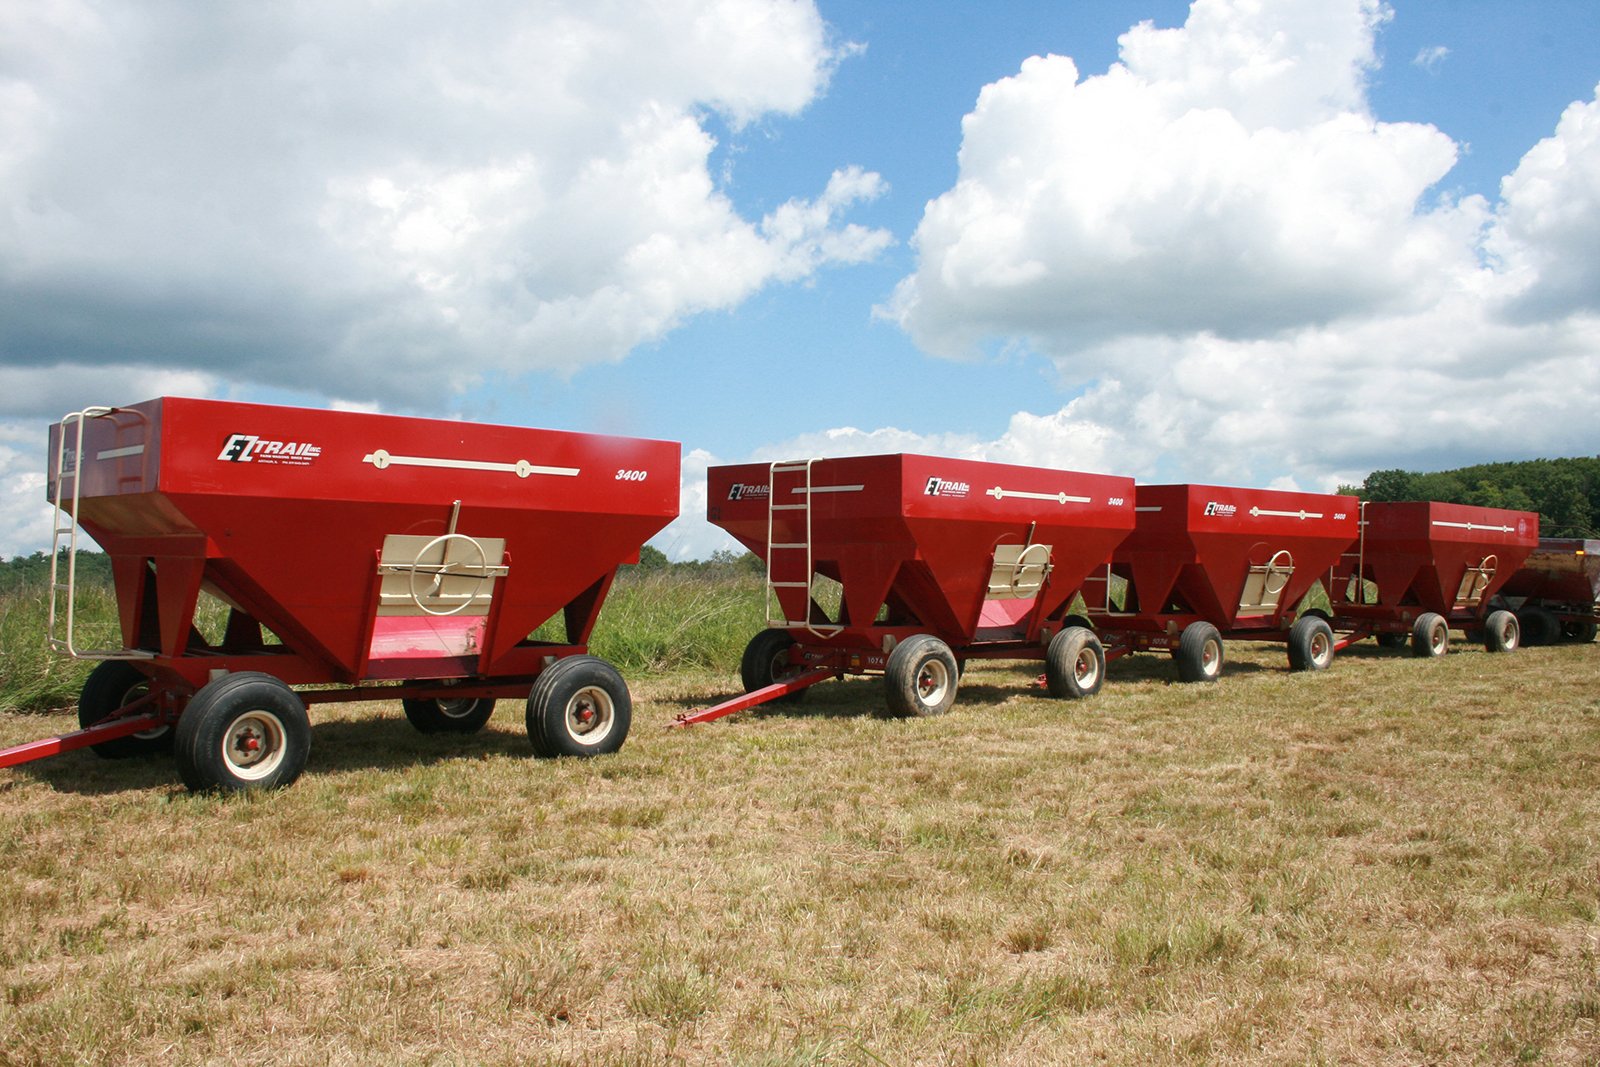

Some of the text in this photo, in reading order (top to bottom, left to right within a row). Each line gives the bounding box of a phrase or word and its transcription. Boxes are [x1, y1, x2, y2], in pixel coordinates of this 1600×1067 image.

[253, 440, 320, 457] TRAIL
[615, 469, 648, 481] 3400
[939, 480, 970, 492] TRAIL
[867, 656, 884, 664] 1074
